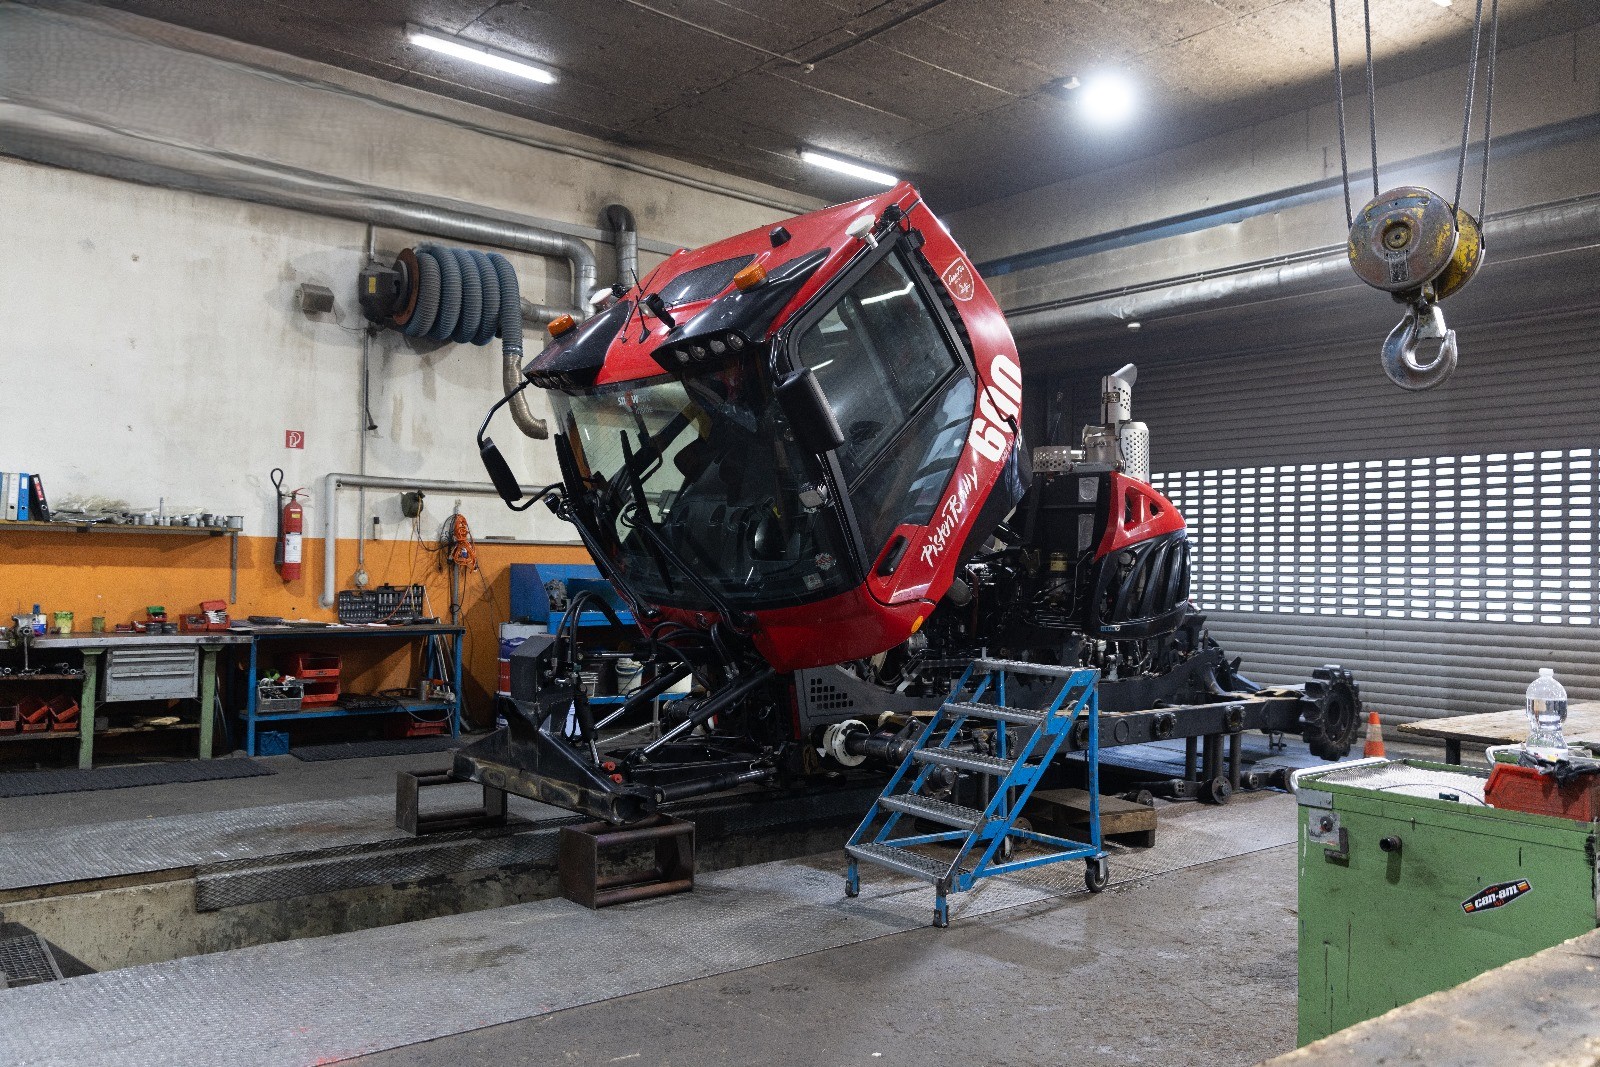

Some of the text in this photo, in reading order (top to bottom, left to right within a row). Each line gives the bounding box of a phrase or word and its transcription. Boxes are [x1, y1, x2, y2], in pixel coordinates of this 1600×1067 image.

[968, 354, 1022, 463] 600
[920, 466, 978, 568] PistenBully
[1474, 884, 1519, 908] can-am
